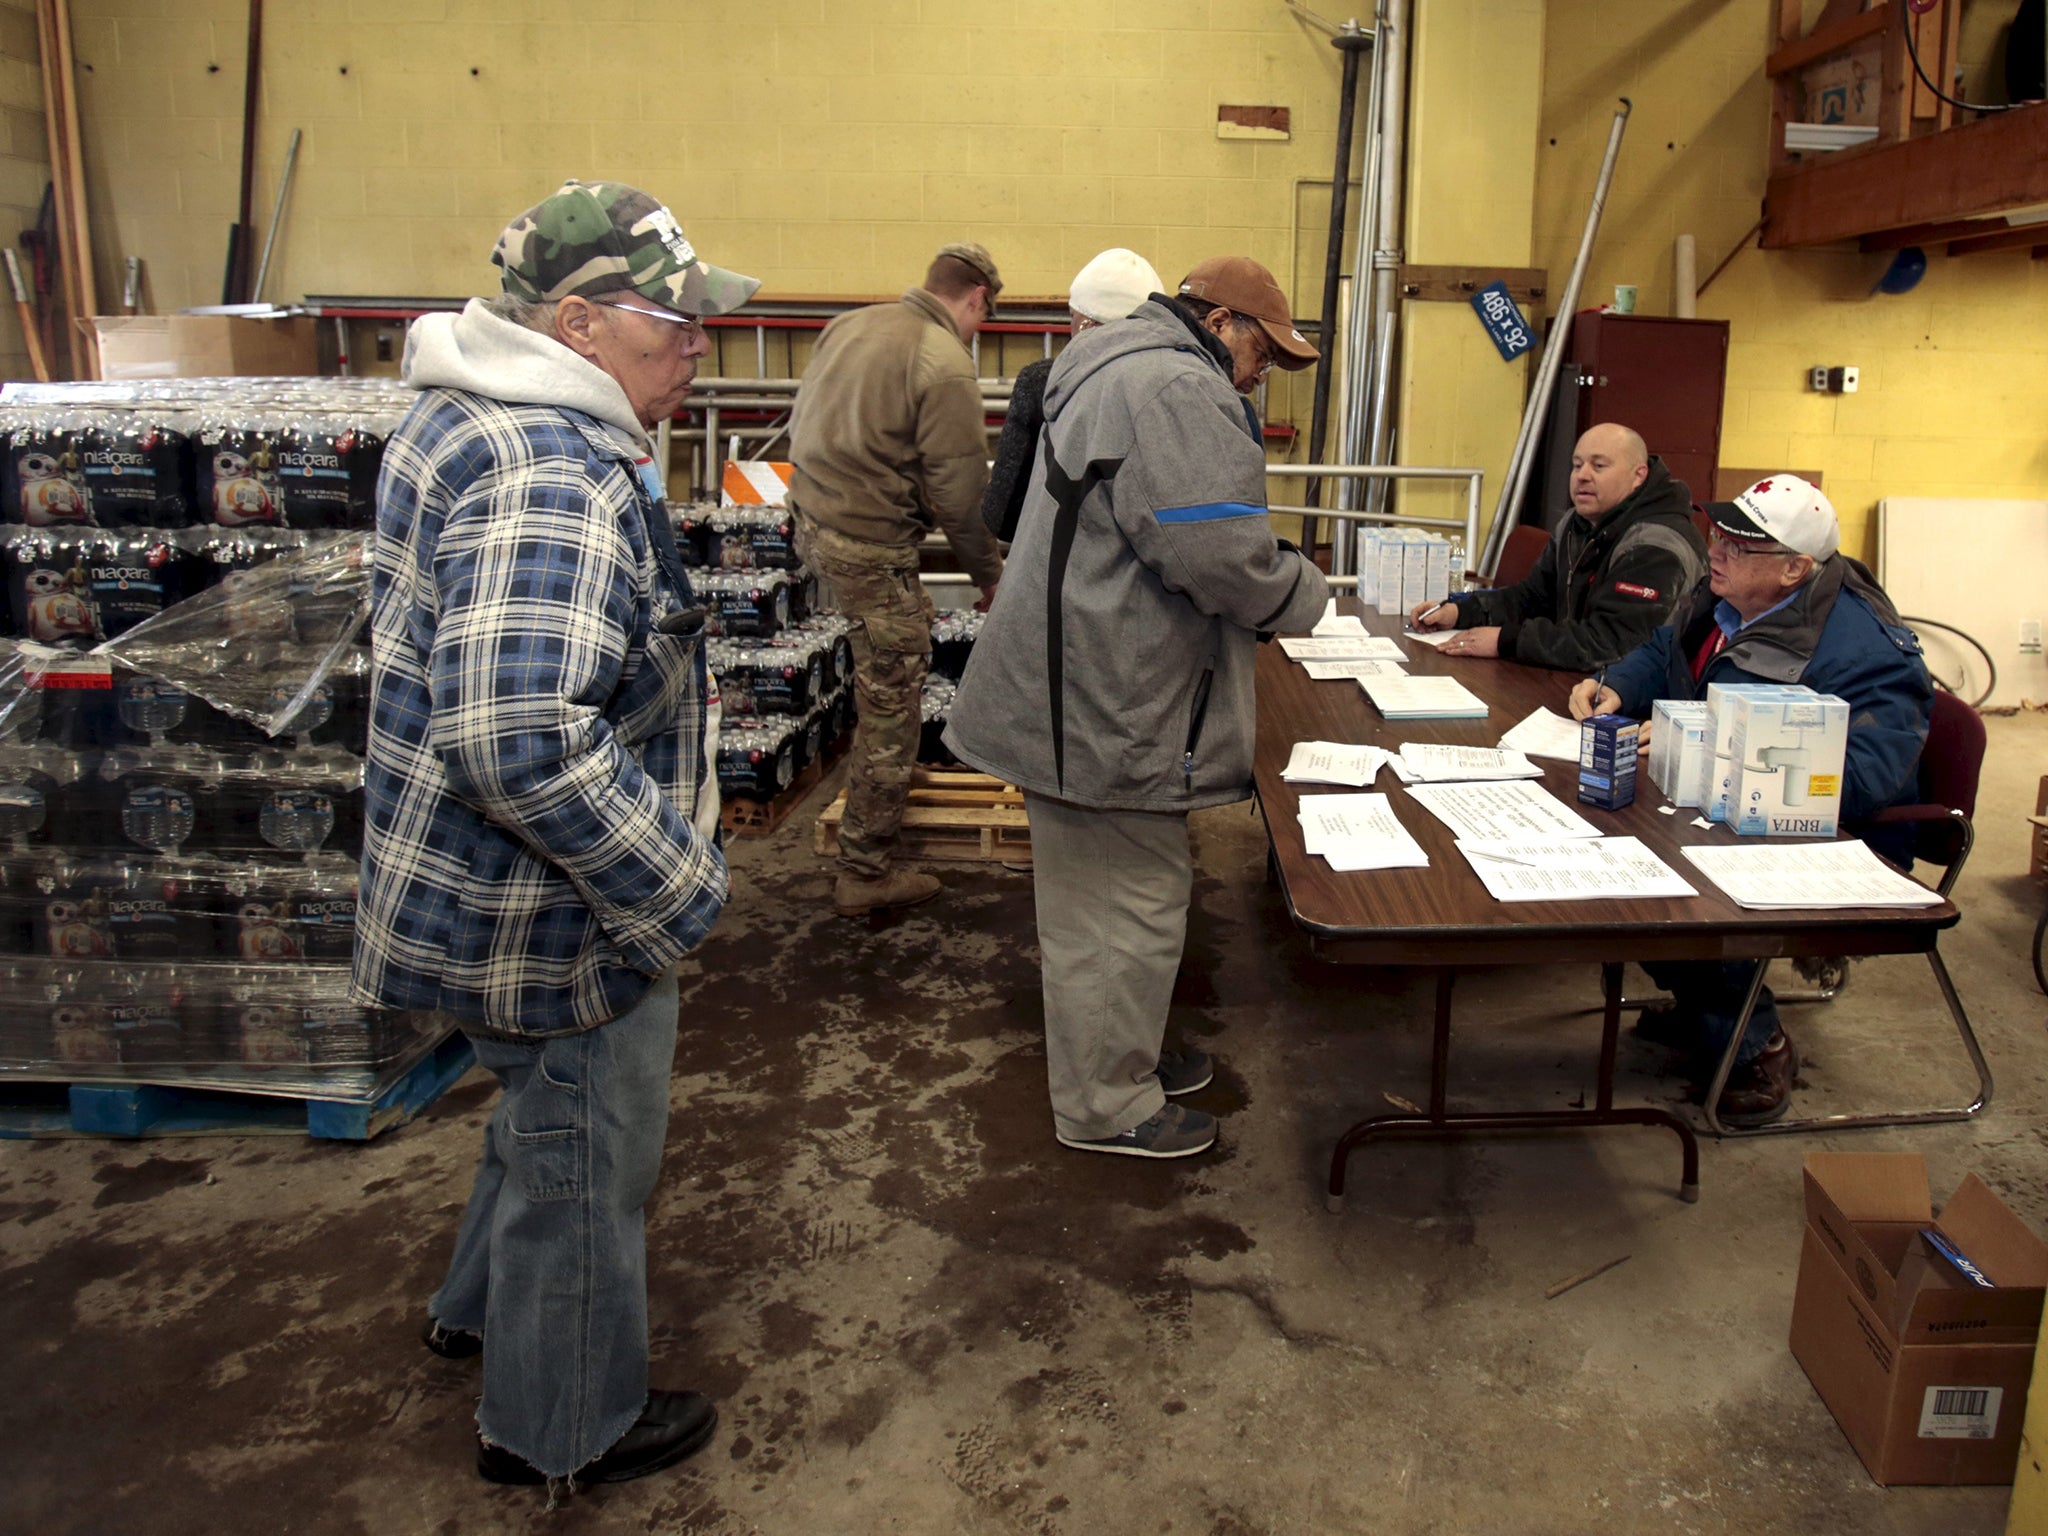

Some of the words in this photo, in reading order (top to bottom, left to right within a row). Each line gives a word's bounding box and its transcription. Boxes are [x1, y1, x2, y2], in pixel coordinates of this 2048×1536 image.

[84, 450, 144, 475] niagara
[279, 451, 338, 477] niagara
[1753, 506, 1768, 523] Cross
[91, 567, 151, 590] niagara
[1773, 818, 1821, 833] BRITA
[108, 899, 166, 922] niagara
